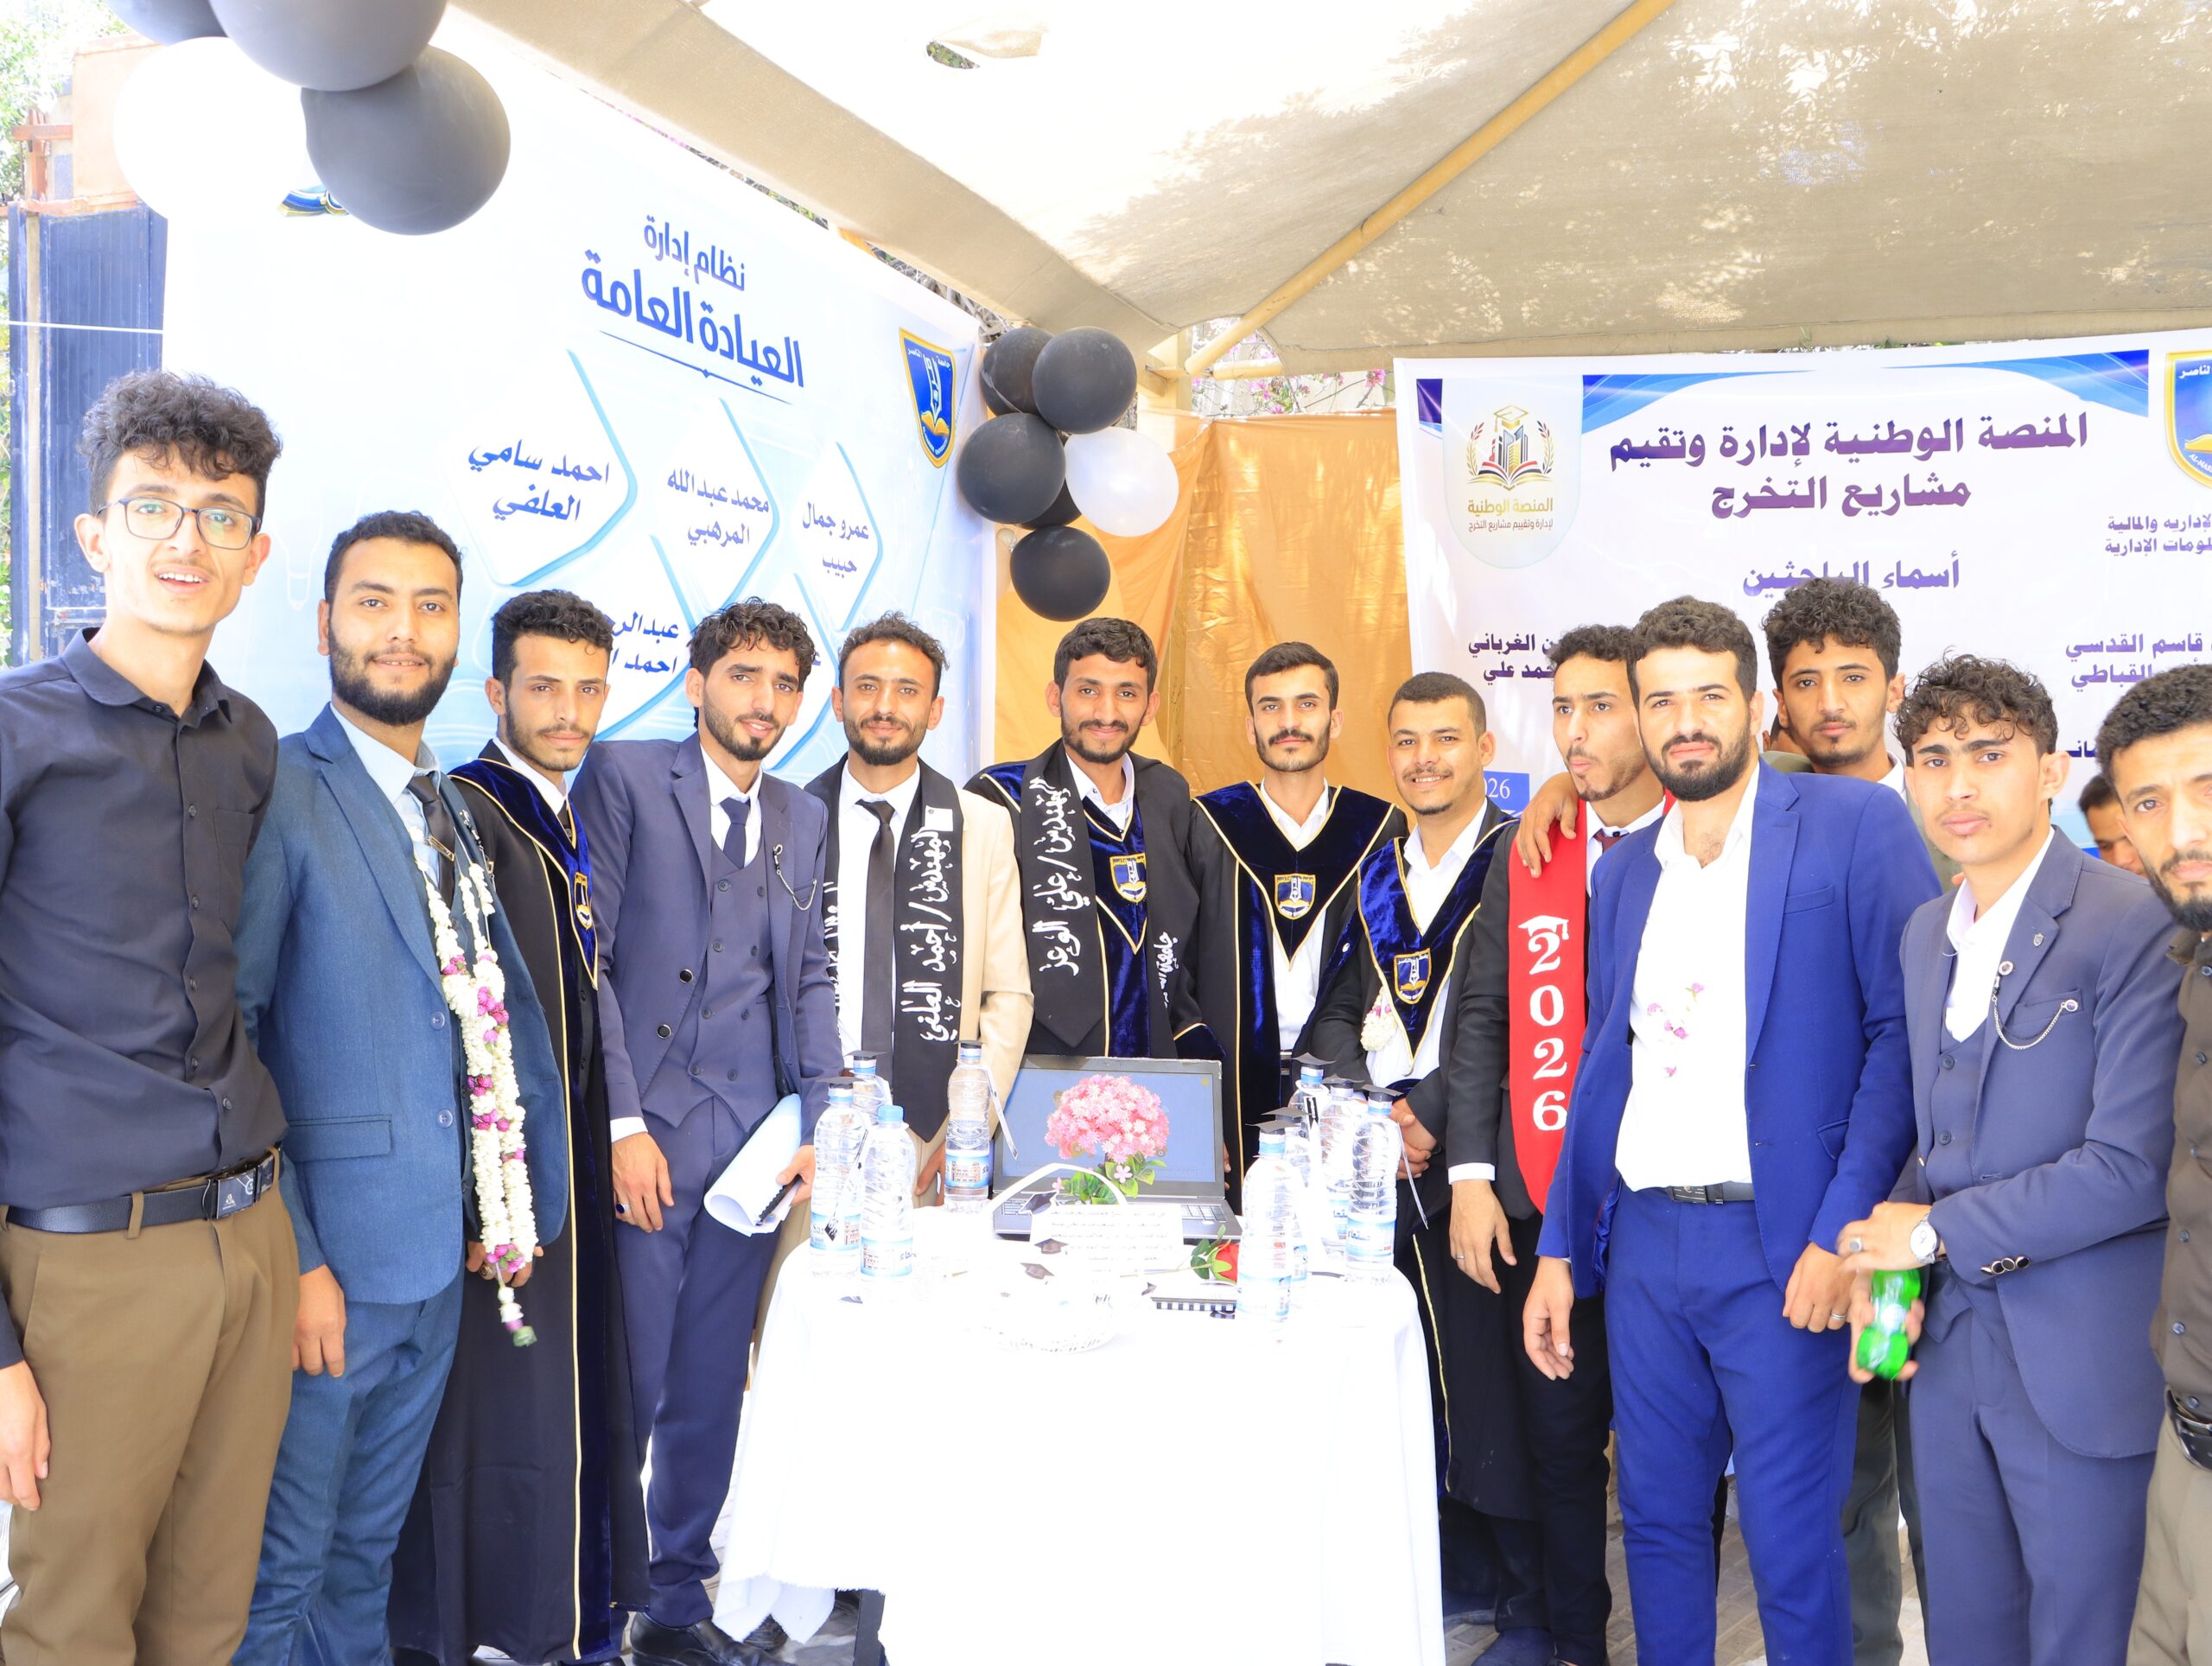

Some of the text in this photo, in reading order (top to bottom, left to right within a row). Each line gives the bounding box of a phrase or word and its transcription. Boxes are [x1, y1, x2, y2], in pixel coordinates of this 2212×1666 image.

[644, 214, 745, 291] نظام إدارة
[581, 249, 804, 388] العيادة العامة
[2178, 364, 2211, 379] لناصر
[1610, 411, 2088, 473] المنصة الوطنية لإدارة وتقيم
[467, 438, 610, 485] احمد سامي
[492, 483, 582, 522] العلفي
[731, 488, 770, 513] محمد
[1467, 497, 1554, 518] المنصة الوطنية
[1711, 471, 1973, 520] مشاريع التخرج
[687, 520, 750, 548] المرهبي
[802, 500, 869, 541] عمرو جمال
[1468, 519, 1487, 533] التخرج
[1488, 518, 1511, 533] مشاريع
[2107, 513, 2212, 535] لإداريه والمالية
[2104, 537, 2212, 557] لومات الإدارية
[822, 554, 858, 579] حبيب
[1882, 550, 1961, 590] أسماء
[1468, 633, 1535, 658] الغرباني
[2065, 633, 2203, 663] قاسم القدسي
[624, 652, 678, 675] احمد
[1483, 660, 1555, 686] حمد علي
[1527, 931, 1568, 1132] 2026
